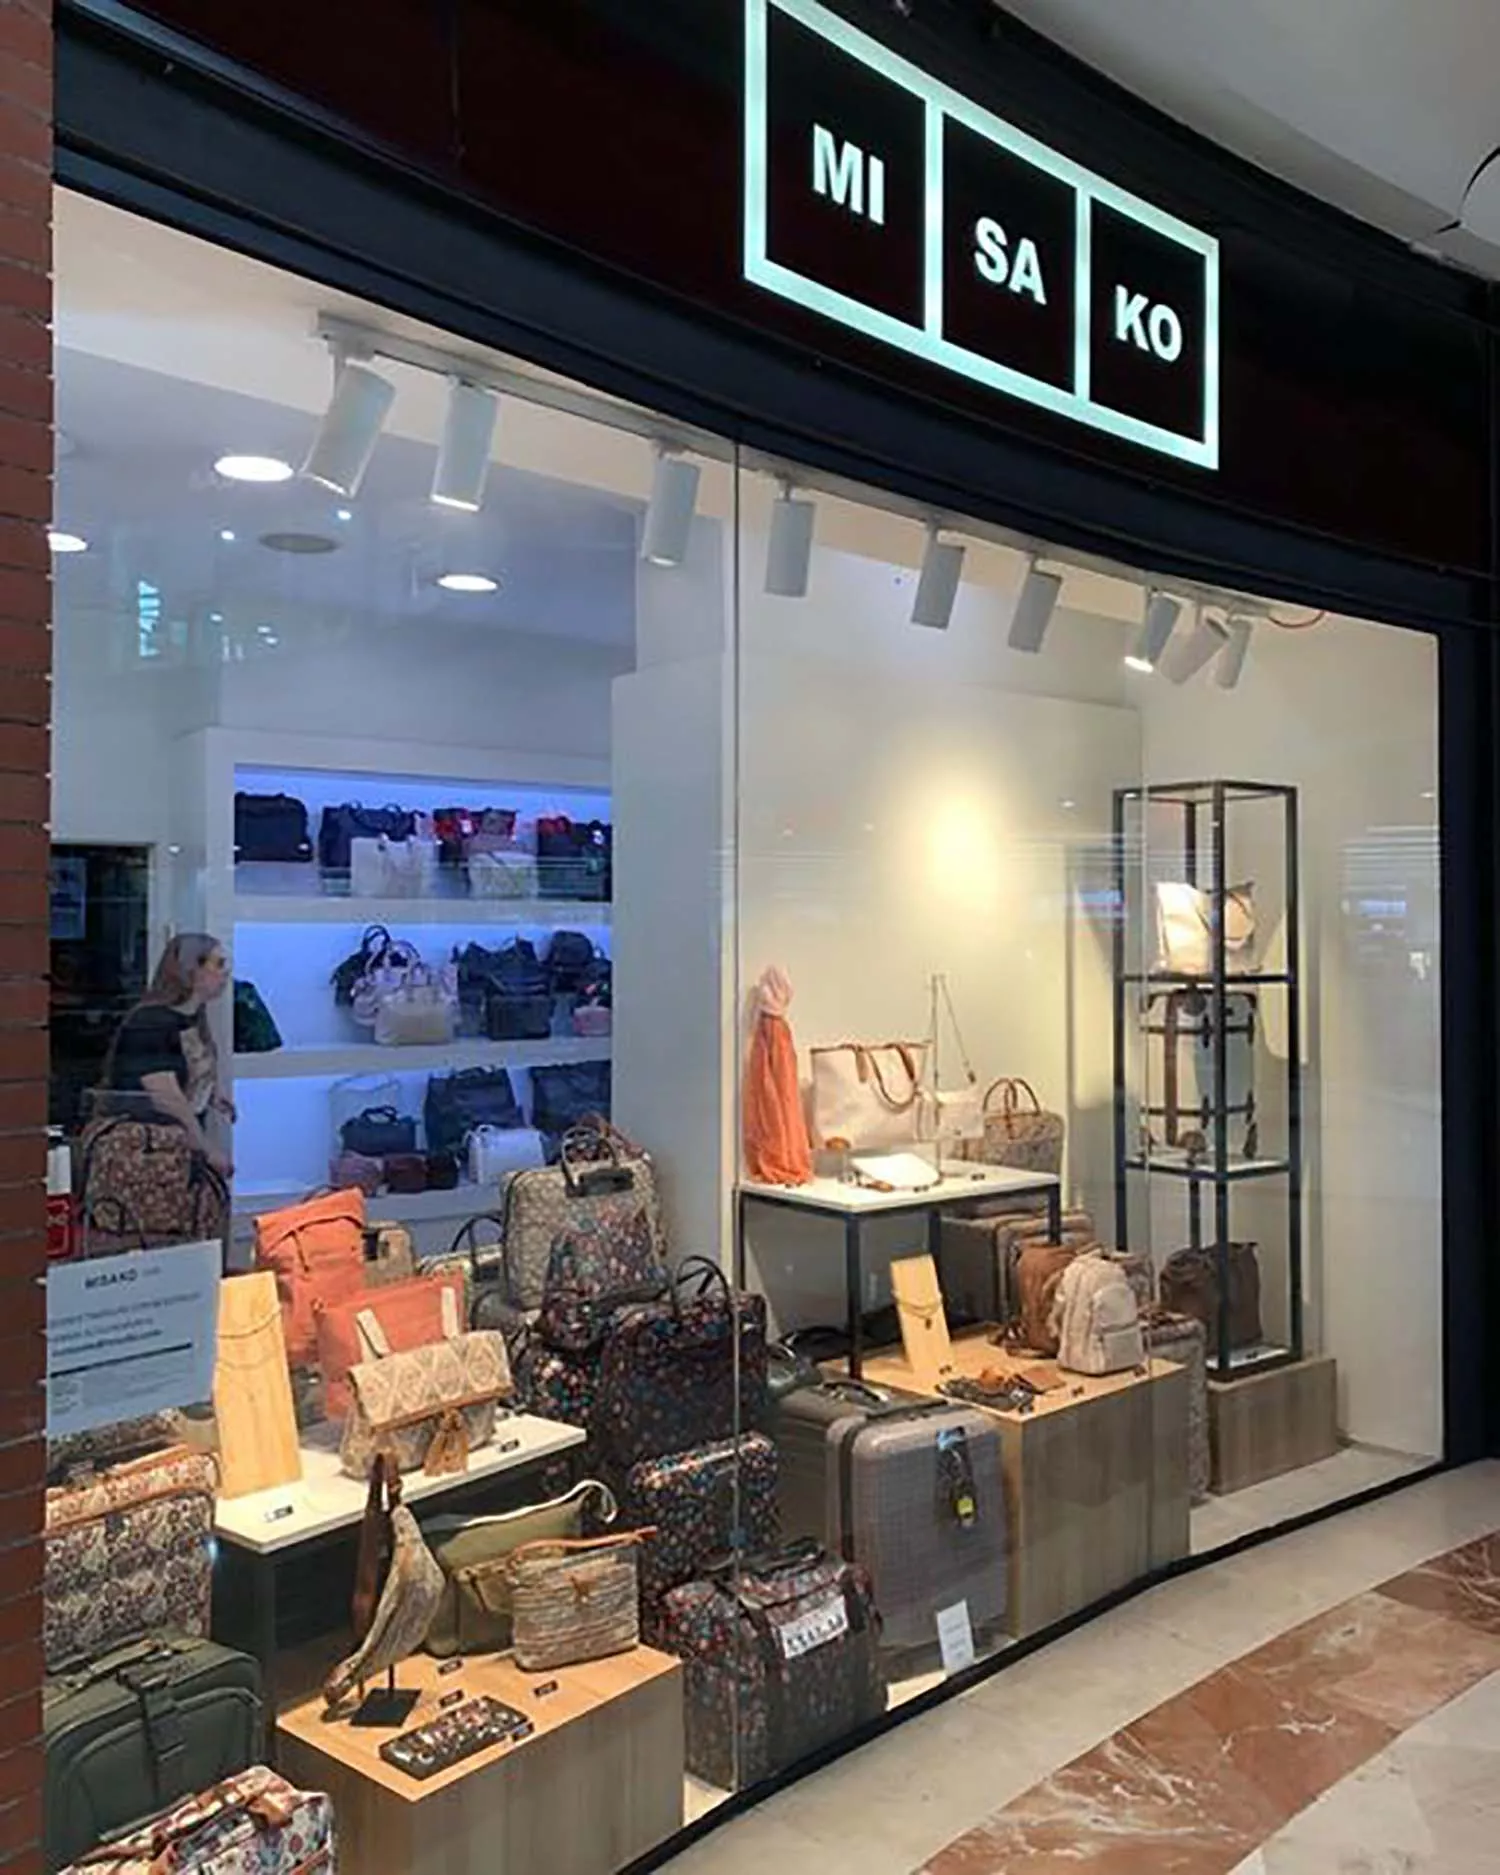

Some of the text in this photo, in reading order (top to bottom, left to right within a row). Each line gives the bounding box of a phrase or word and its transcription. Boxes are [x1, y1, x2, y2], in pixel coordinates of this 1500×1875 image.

[813, 124, 1182, 362] MI SA KO
